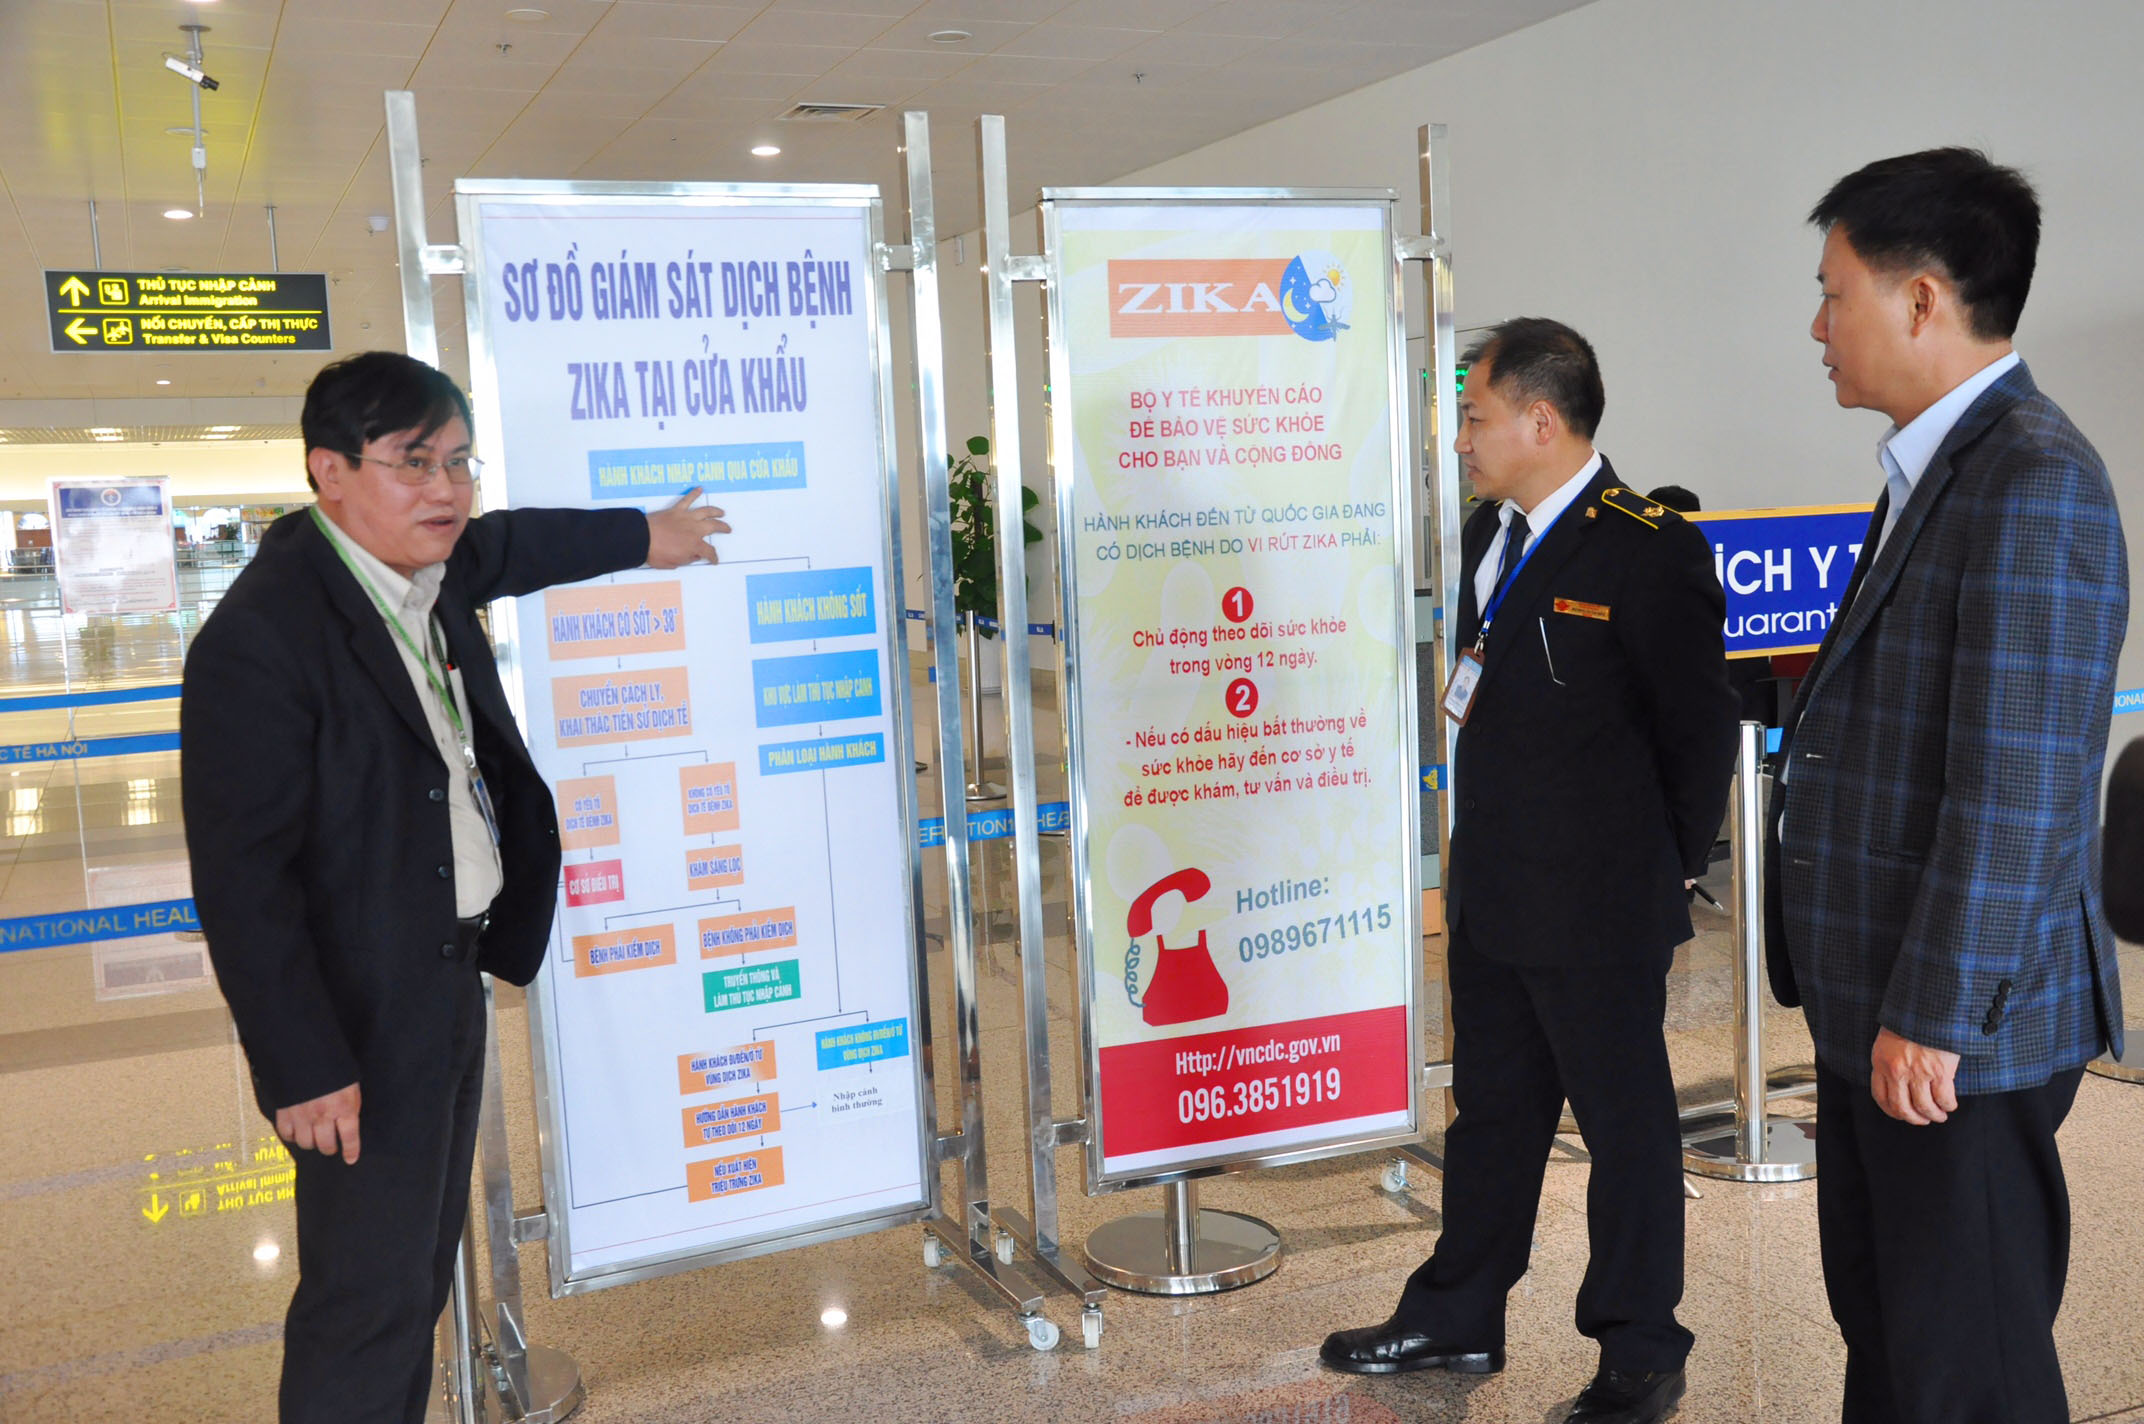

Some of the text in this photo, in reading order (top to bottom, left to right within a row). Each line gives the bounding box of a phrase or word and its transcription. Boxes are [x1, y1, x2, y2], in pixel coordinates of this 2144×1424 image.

[139, 293, 258, 308] Arrival Immigration
[502, 242, 853, 331] SƠ ĐỒ GIÁM SÁT DỊCH BỆNH
[1117, 282, 1284, 314] ZIKA
[142, 333, 296, 344] Transfer & Visa Counters
[567, 334, 808, 430] ZIKA TẠI CỬA KHẨU
[1162, 391, 1173, 407] Y
[1285, 382, 1322, 404] CÁO
[1232, 413, 1270, 434] SỨC
[1119, 450, 1158, 468] CHO
[1164, 449, 1200, 471] BẠN
[1206, 443, 1230, 465] VÀ
[1084, 512, 1129, 532] HÀNH
[1136, 509, 1191, 529] KHÁCH
[1312, 504, 1339, 520] GIA
[1343, 502, 1385, 518] ĐANG
[1096, 540, 1120, 561] CÓ
[1220, 538, 1243, 554] DO
[1248, 537, 1262, 552] VI
[1269, 532, 1299, 551] RÚT
[1303, 533, 1337, 550] ZIKA
[1808, 545, 1838, 589] Y
[1231, 591, 1243, 617] 1
[1132, 616, 1347, 649] Chủ động theo dõi sức khỏe
[1169, 648, 1318, 677] trong vòng 12 ngày.
[1235, 684, 1251, 711] 2
[560, 717, 583, 737] KHAI
[1136, 707, 1367, 748] Nếu có dấu hiệu bất thường về
[1142, 737, 1354, 777] sức khỏe hãy đến cơ sở y tế
[1124, 767, 1371, 807] để được khám, tư vấn và điều trị.
[1236, 876, 1329, 913] Hotline:
[1239, 903, 1391, 963] 0989671115
[1175, 1033, 1341, 1076] Http://vncdc.gov.vn
[1178, 1067, 1341, 1124] 096.3851919
